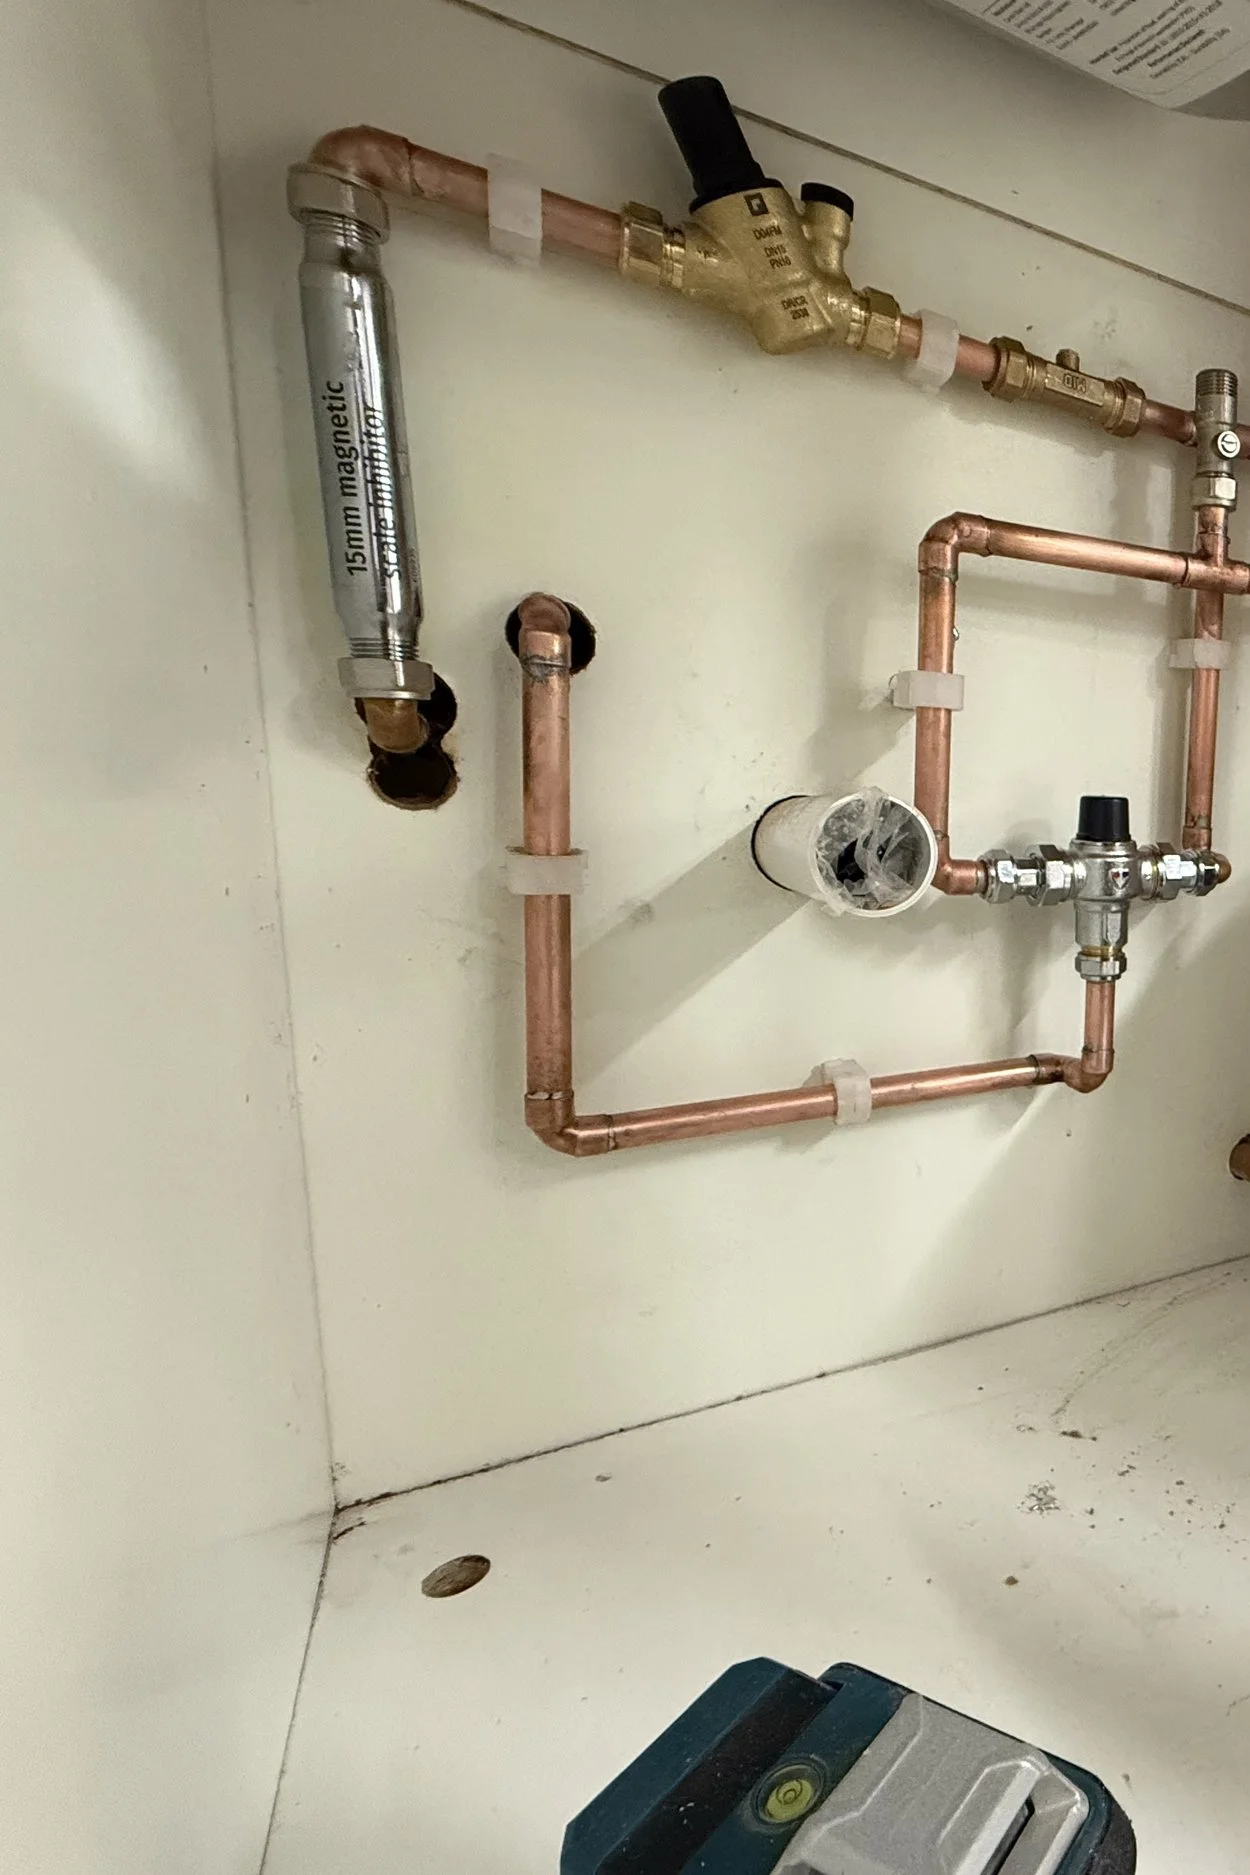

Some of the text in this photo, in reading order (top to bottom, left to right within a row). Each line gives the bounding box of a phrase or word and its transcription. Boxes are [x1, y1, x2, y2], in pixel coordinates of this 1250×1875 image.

[322, 379, 368, 576] 15mm magnetic
[373, 518, 402, 580] scale
